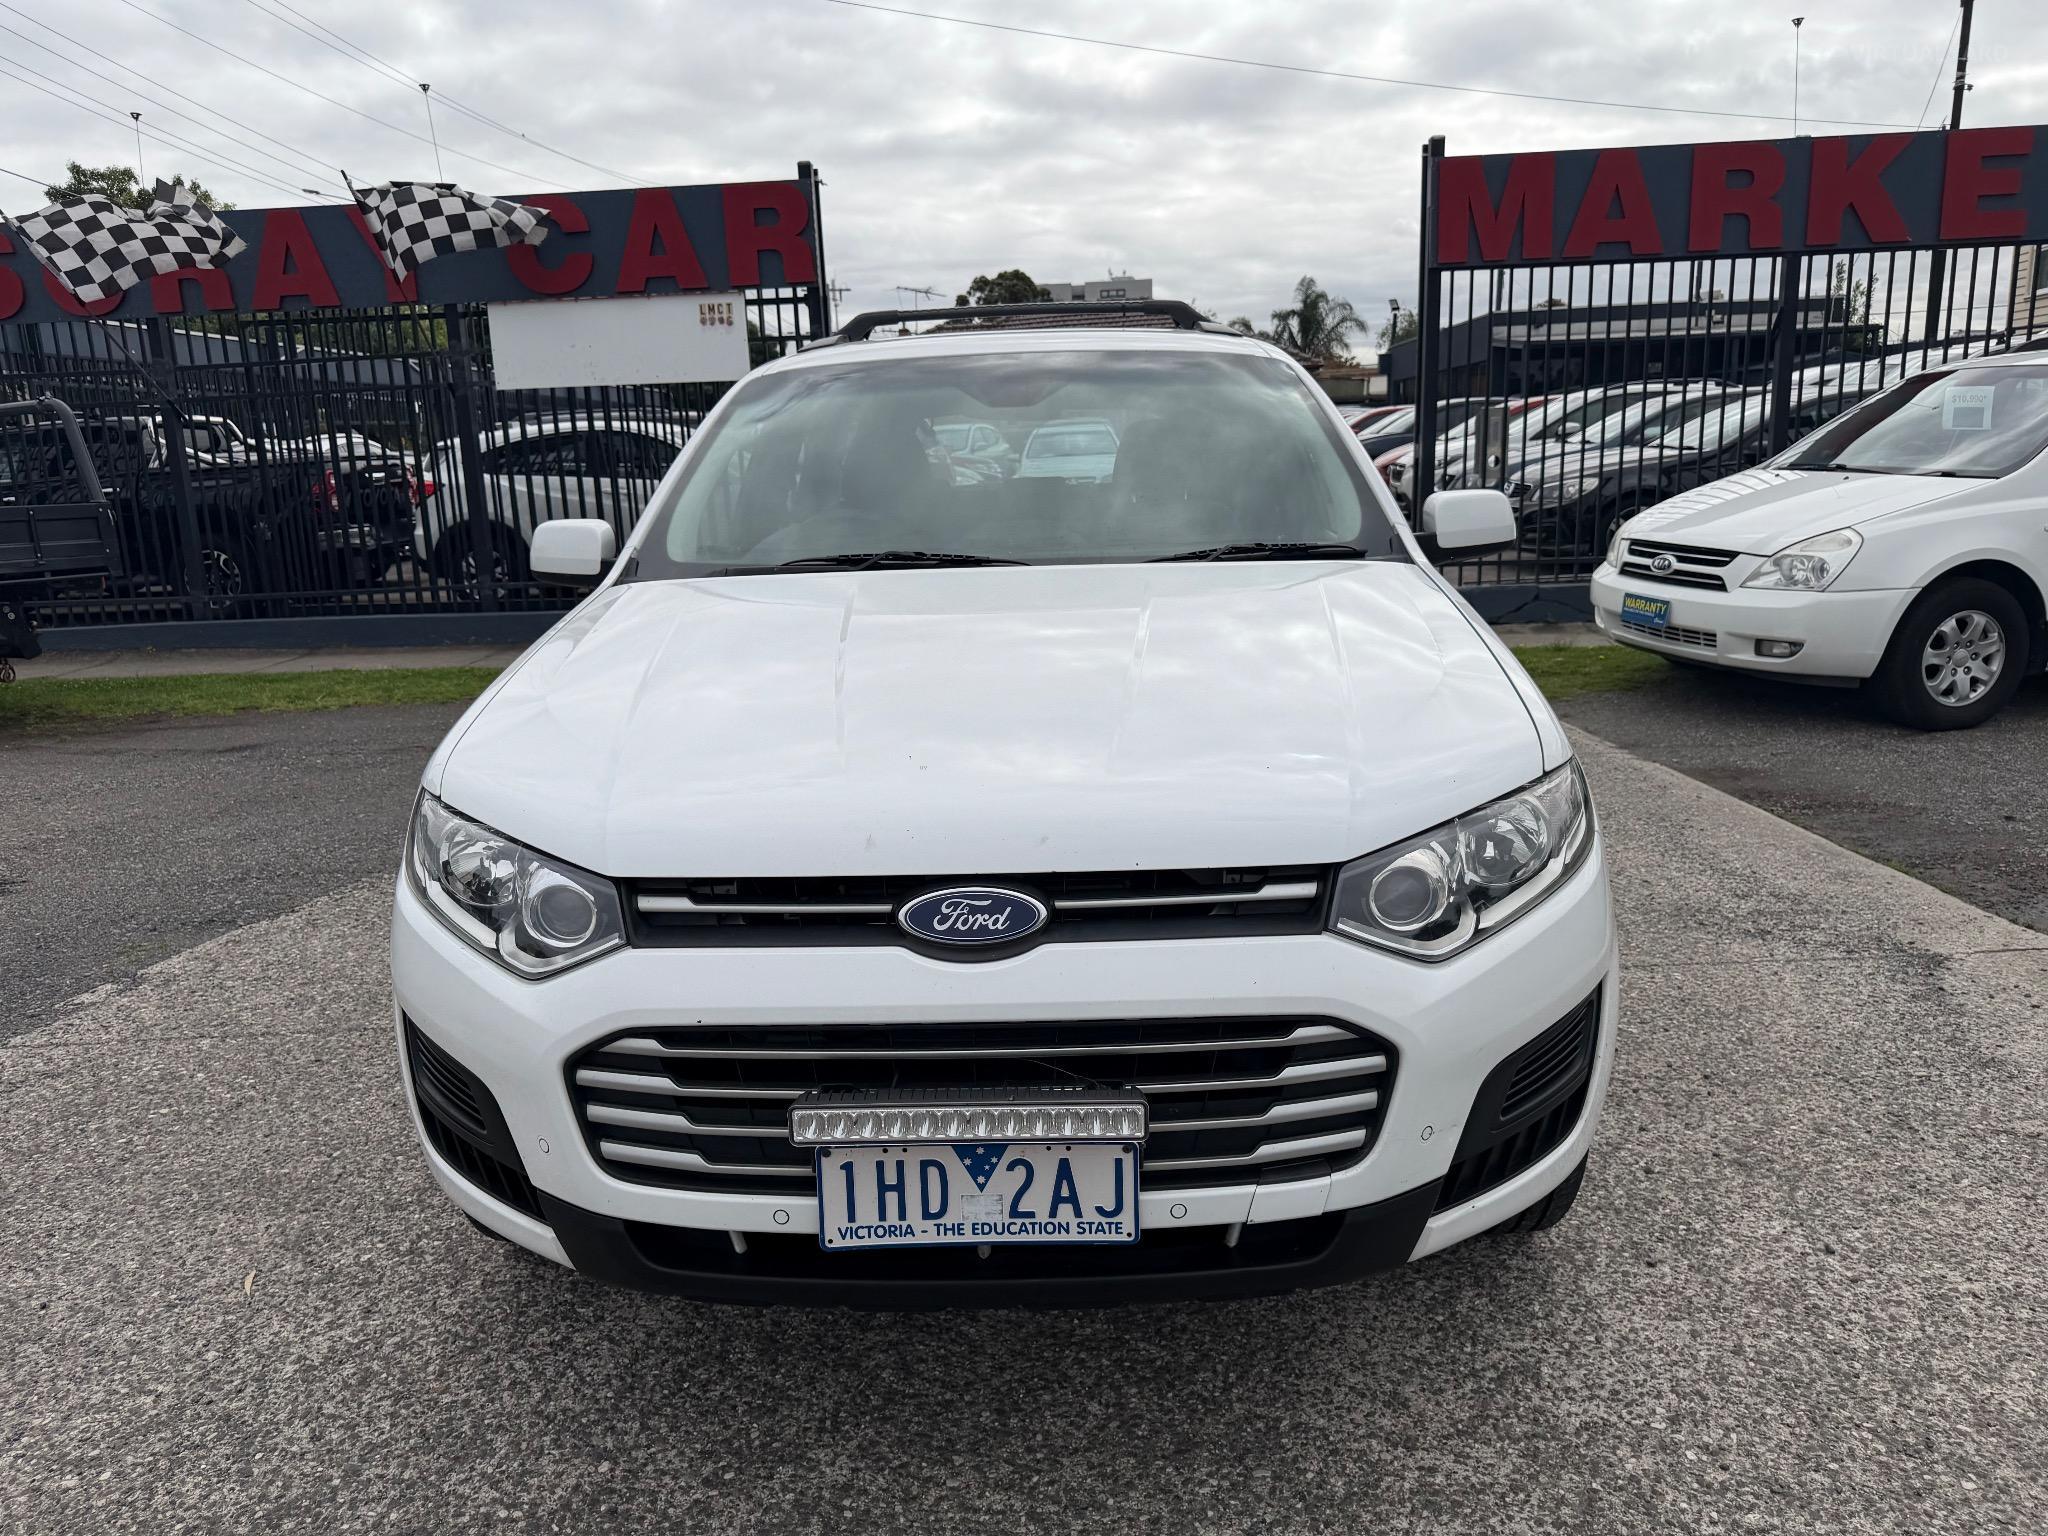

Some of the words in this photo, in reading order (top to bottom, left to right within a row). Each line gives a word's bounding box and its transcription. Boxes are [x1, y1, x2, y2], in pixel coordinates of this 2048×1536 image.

[506, 182, 817, 295] CAR
[1437, 125, 2036, 266] MARKE
[698, 303, 733, 316] LMCT
[1652, 558, 1669, 570] KIA
[1624, 597, 1667, 615] WARRANTY
[932, 898, 1011, 932] Ford
[839, 1159, 949, 1224] 1HD
[1005, 1157, 1124, 1220] 2AJ
[837, 1223, 916, 1240] VICTORIA
[934, 1222, 965, 1237] THE
[971, 1221, 1071, 1237] EDUCATION
[1076, 1221, 1124, 1235] STATE
